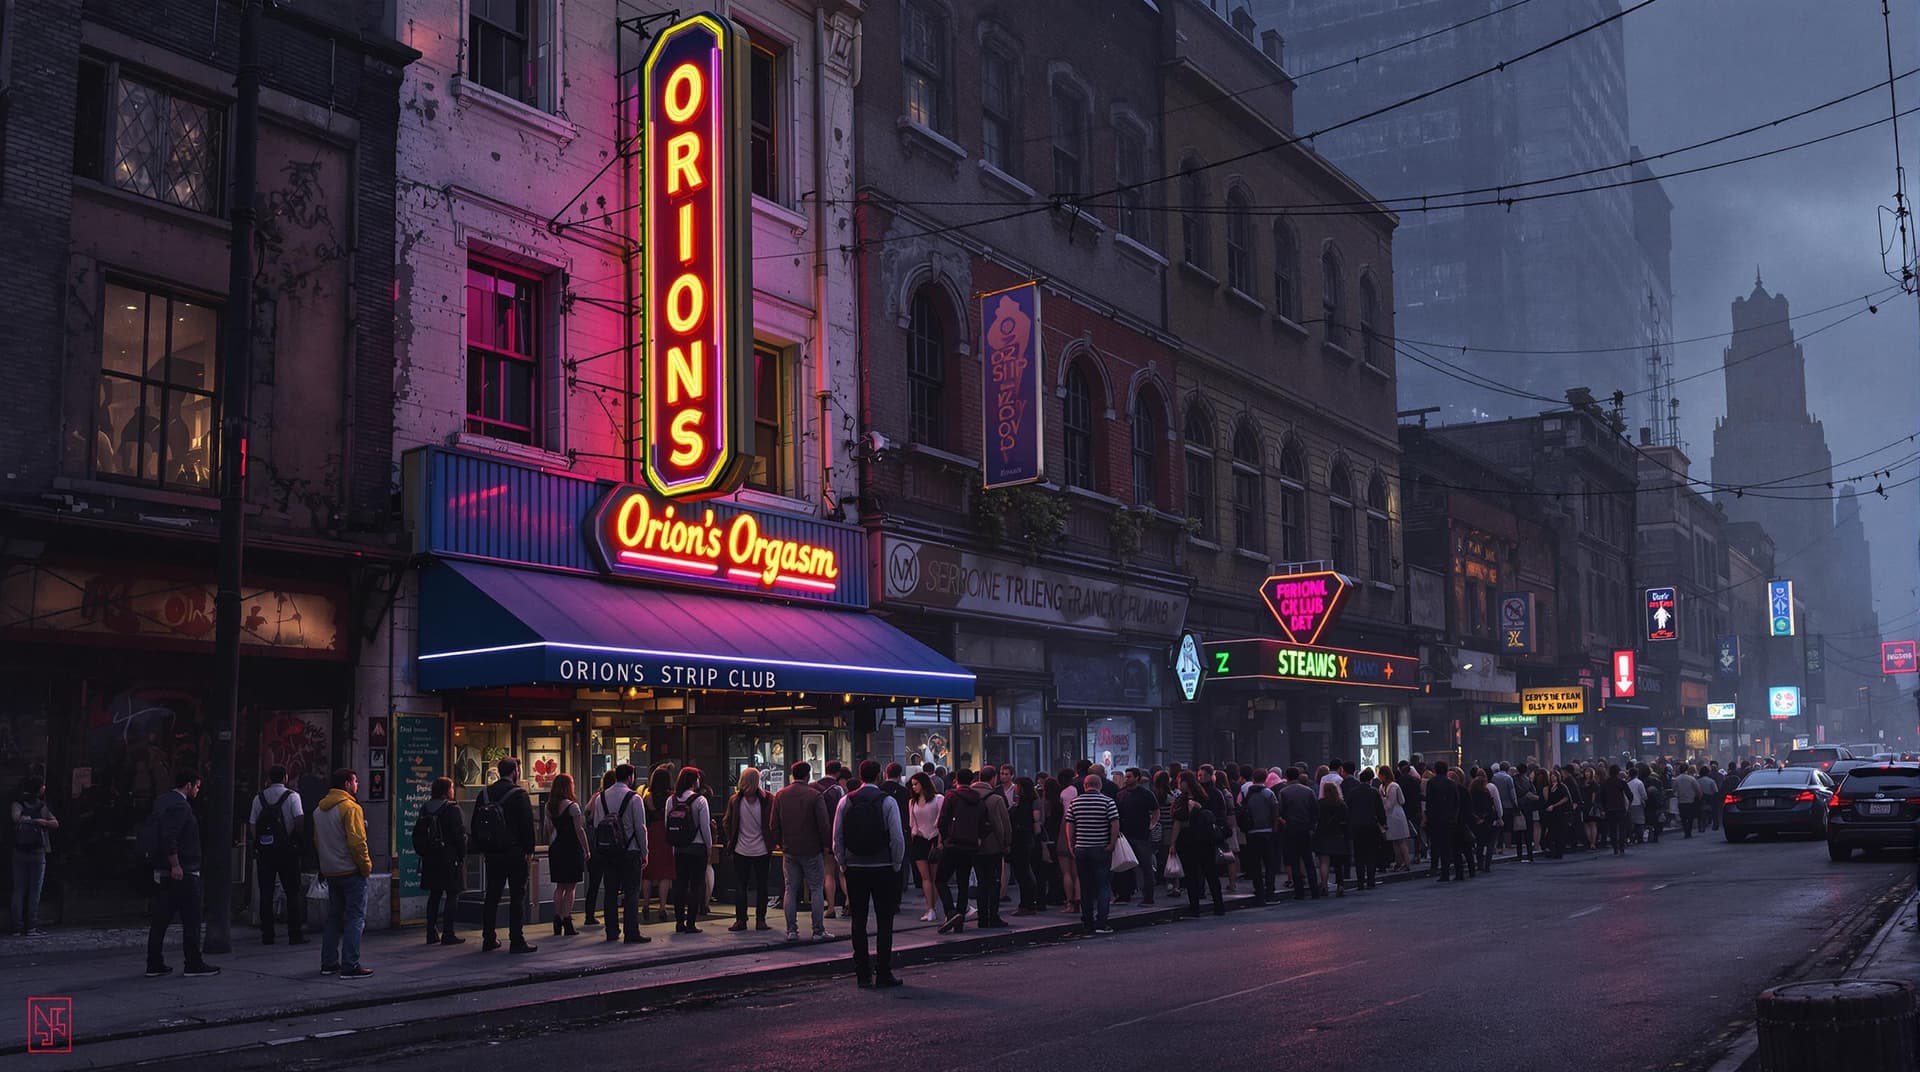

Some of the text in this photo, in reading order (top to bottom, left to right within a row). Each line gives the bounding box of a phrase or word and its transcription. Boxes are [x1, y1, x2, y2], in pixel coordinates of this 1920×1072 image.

[664, 62, 705, 468] ORIONS
[617, 493, 838, 587] Orion's Orgasm
[560, 659, 776, 688] ORION'S STRIP CLUB
[1215, 652, 1230, 673] Z
[1278, 649, 1337, 678] STEAWS
